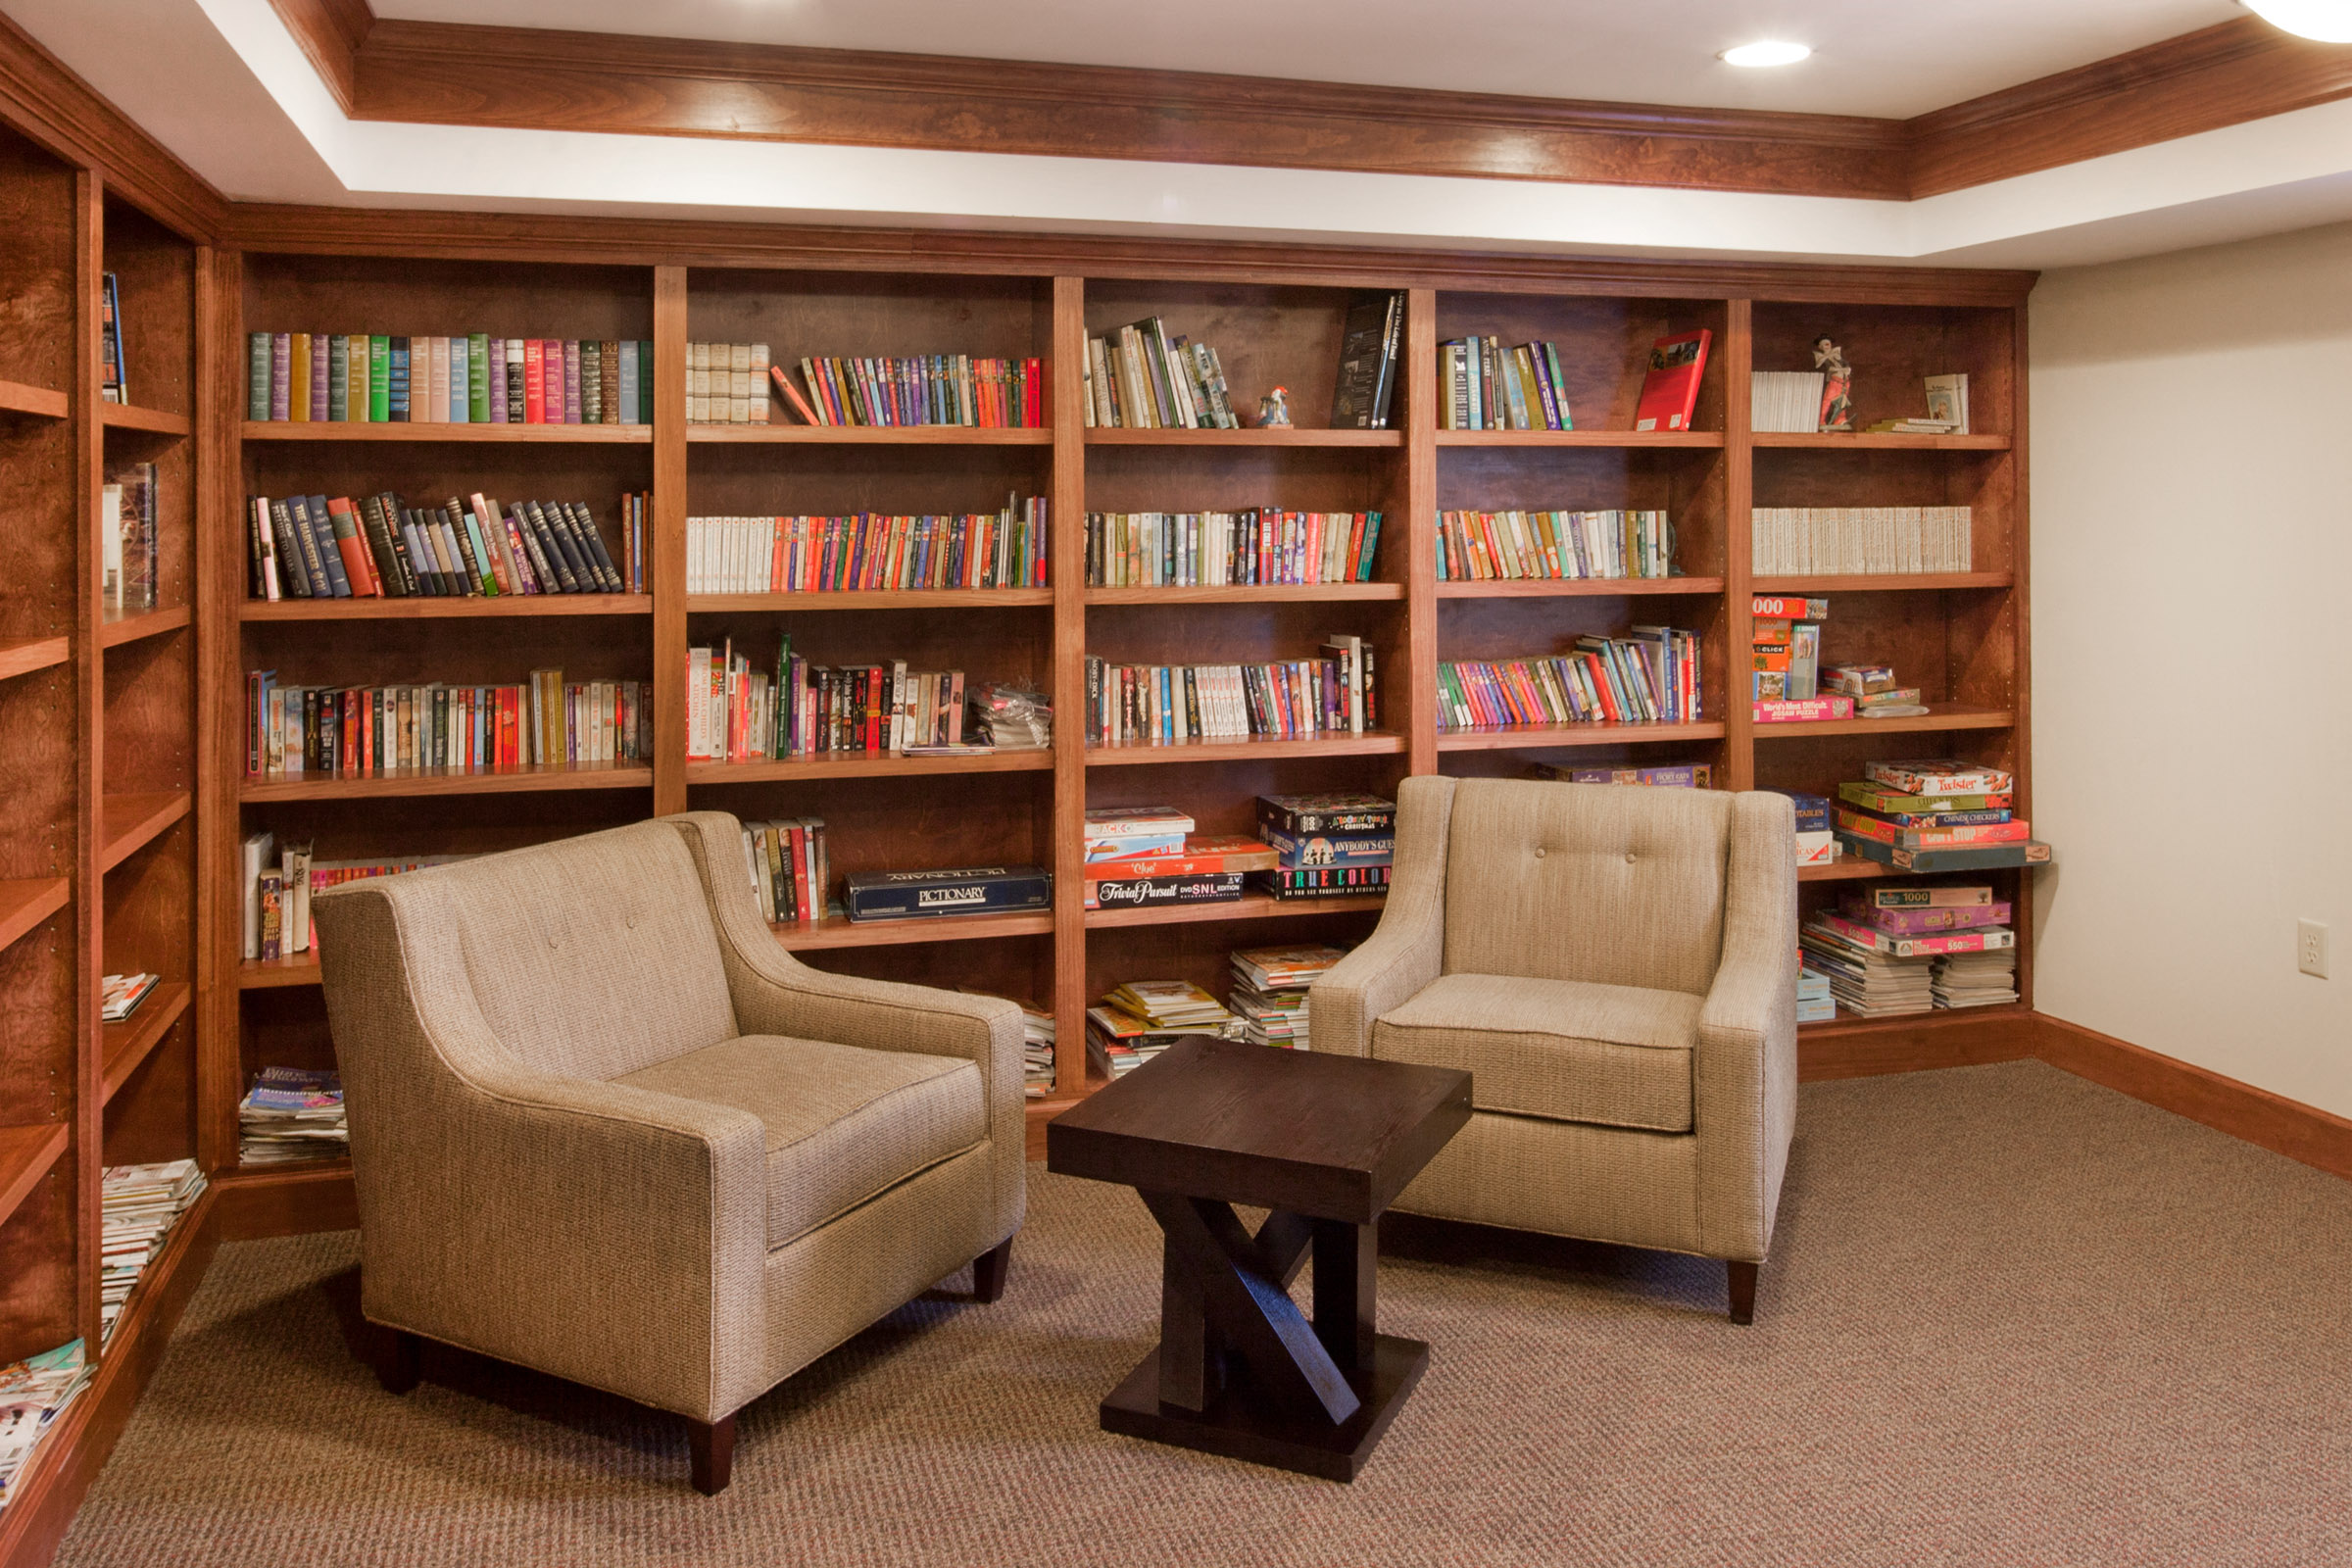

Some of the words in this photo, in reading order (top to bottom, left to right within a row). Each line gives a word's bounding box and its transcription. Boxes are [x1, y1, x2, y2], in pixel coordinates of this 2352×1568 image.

[294, 504, 306, 521] THE
[298, 522, 319, 570] HARVESTER
[1752, 600, 1784, 614] 000
[711, 671, 721, 698] ZONE
[1763, 703, 1785, 711] World's
[1874, 766, 1900, 784] Twister
[1937, 778, 1977, 792] Twister
[1944, 813, 1969, 823] CHINESE
[1970, 812, 2000, 821] CHECKERS
[1952, 828, 1977, 841] STOP
[1335, 841, 1377, 852] ANYBODY'S
[891, 868, 1007, 881] PICTIONARY
[1284, 870, 1329, 888] TRUE
[919, 887, 986, 902] PICTIONARY
[1100, 882, 1139, 902] Trivial
[1134, 880, 1178, 904] Pursuit
[1192, 883, 1217, 895] SNL
[1903, 893, 1929, 902] 1000
